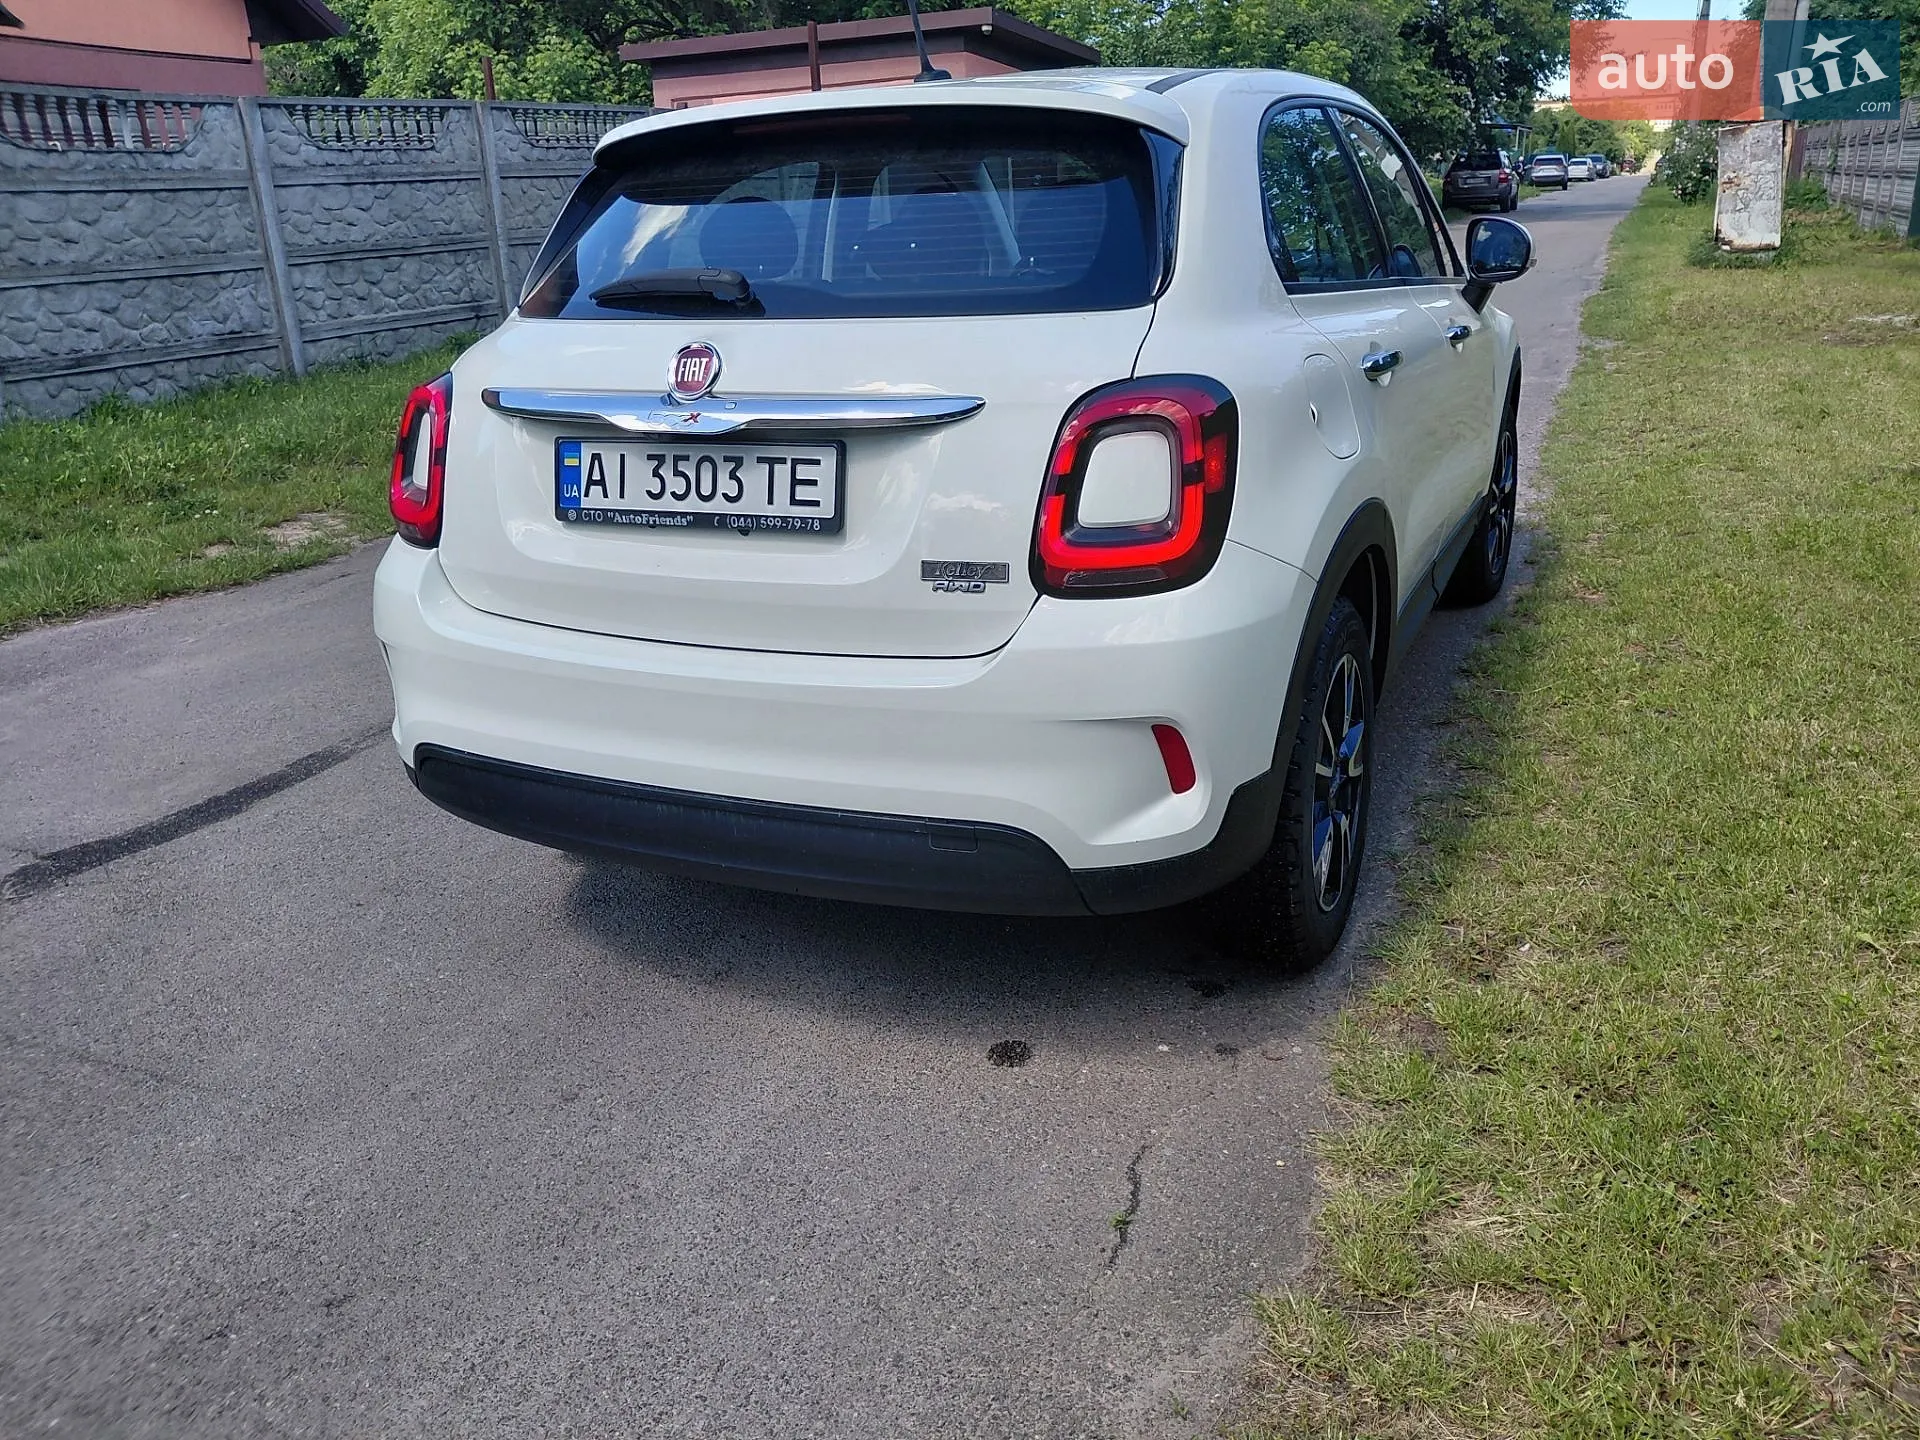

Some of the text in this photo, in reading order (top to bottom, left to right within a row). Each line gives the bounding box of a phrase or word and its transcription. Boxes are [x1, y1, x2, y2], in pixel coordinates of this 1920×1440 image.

[677, 357, 710, 382] FIAT
[583, 452, 822, 507] AI 3503 TE
[563, 483, 580, 498] UA
[607, 511, 694, 526] "AutoFriends"
[726, 515, 821, 531] (044) 599-79-78
[931, 580, 986, 593] AWD
